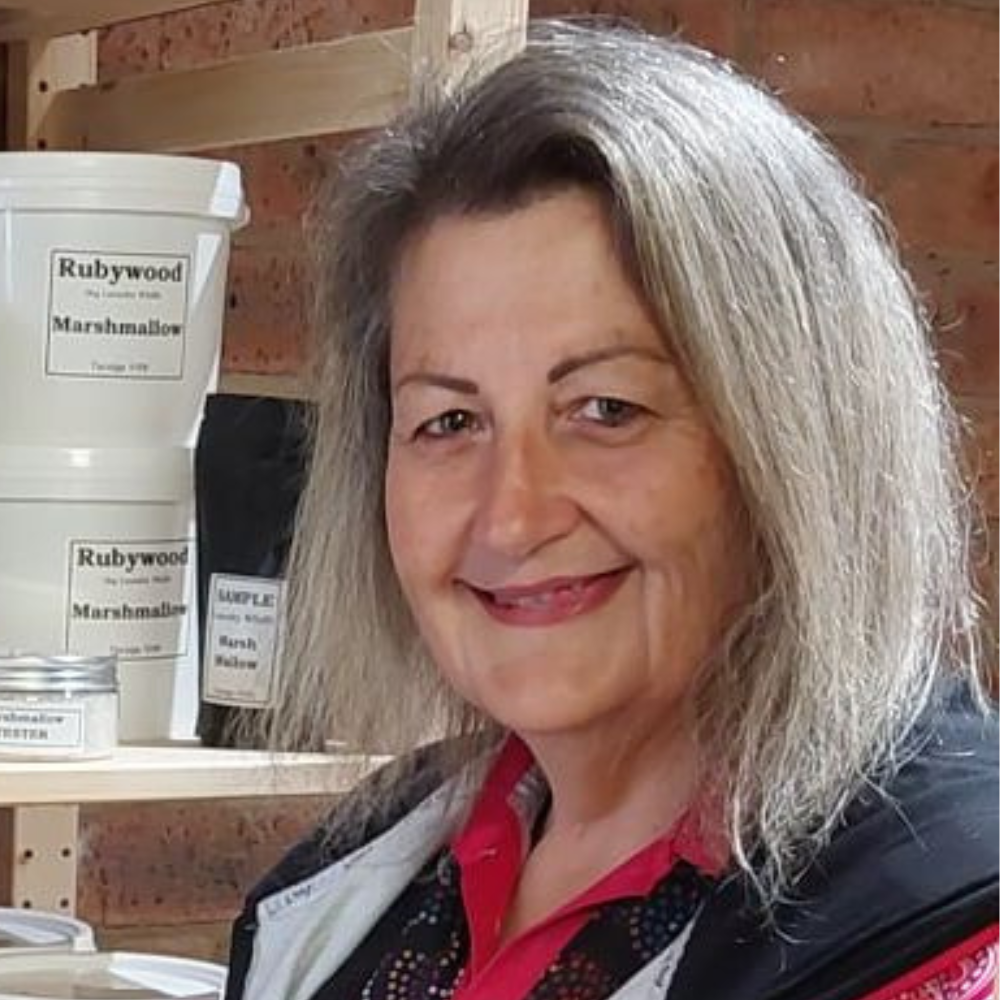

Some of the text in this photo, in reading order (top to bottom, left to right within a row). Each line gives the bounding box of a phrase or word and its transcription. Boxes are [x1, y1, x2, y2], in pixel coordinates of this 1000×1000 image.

[59, 258, 182, 285] Rubywood
[52, 315, 181, 336] Marshmallow
[78, 545, 188, 573] Rubywood
